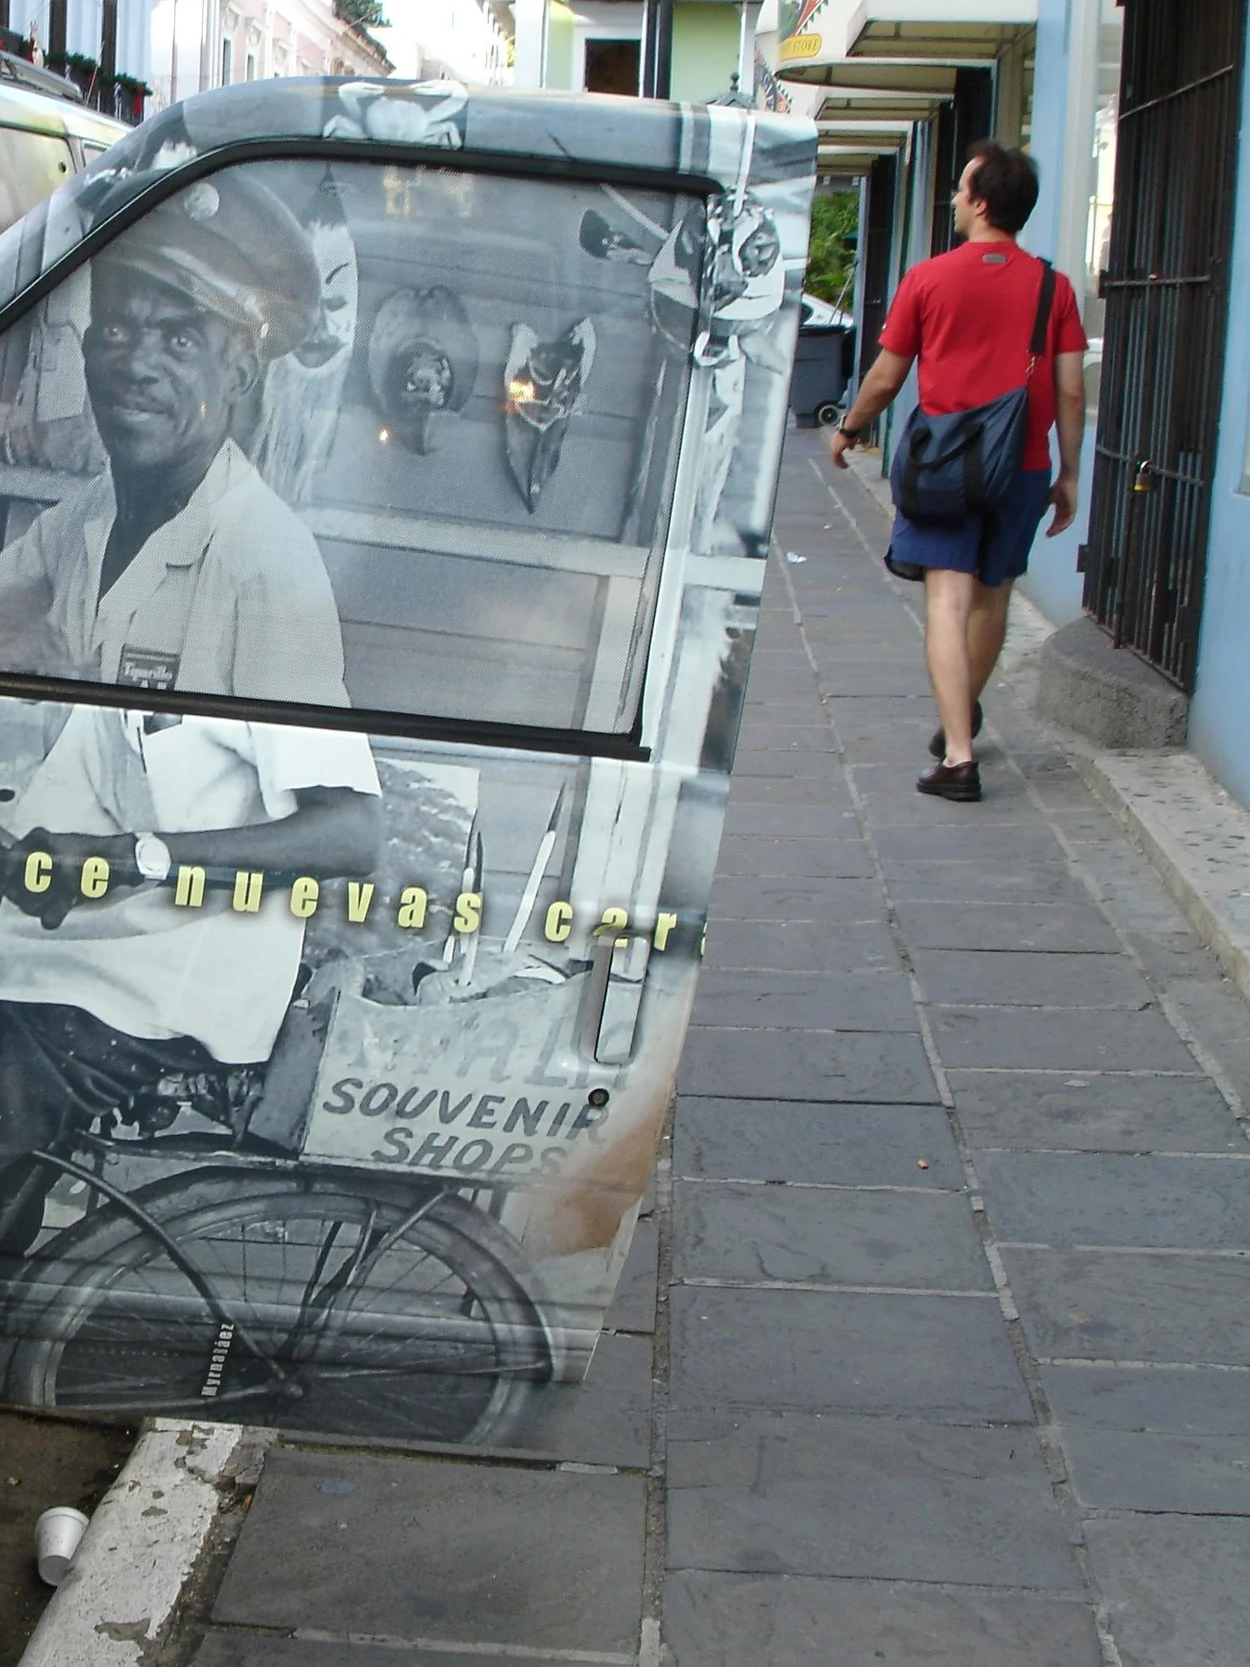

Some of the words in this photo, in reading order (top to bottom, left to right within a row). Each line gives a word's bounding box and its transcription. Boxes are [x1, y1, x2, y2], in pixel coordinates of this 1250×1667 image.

[174, 864, 481, 934] nuevas
[544, 900, 707, 955] car
[323, 1078, 610, 1143] SOUVENIR
[371, 1127, 568, 1176] SHOPS
